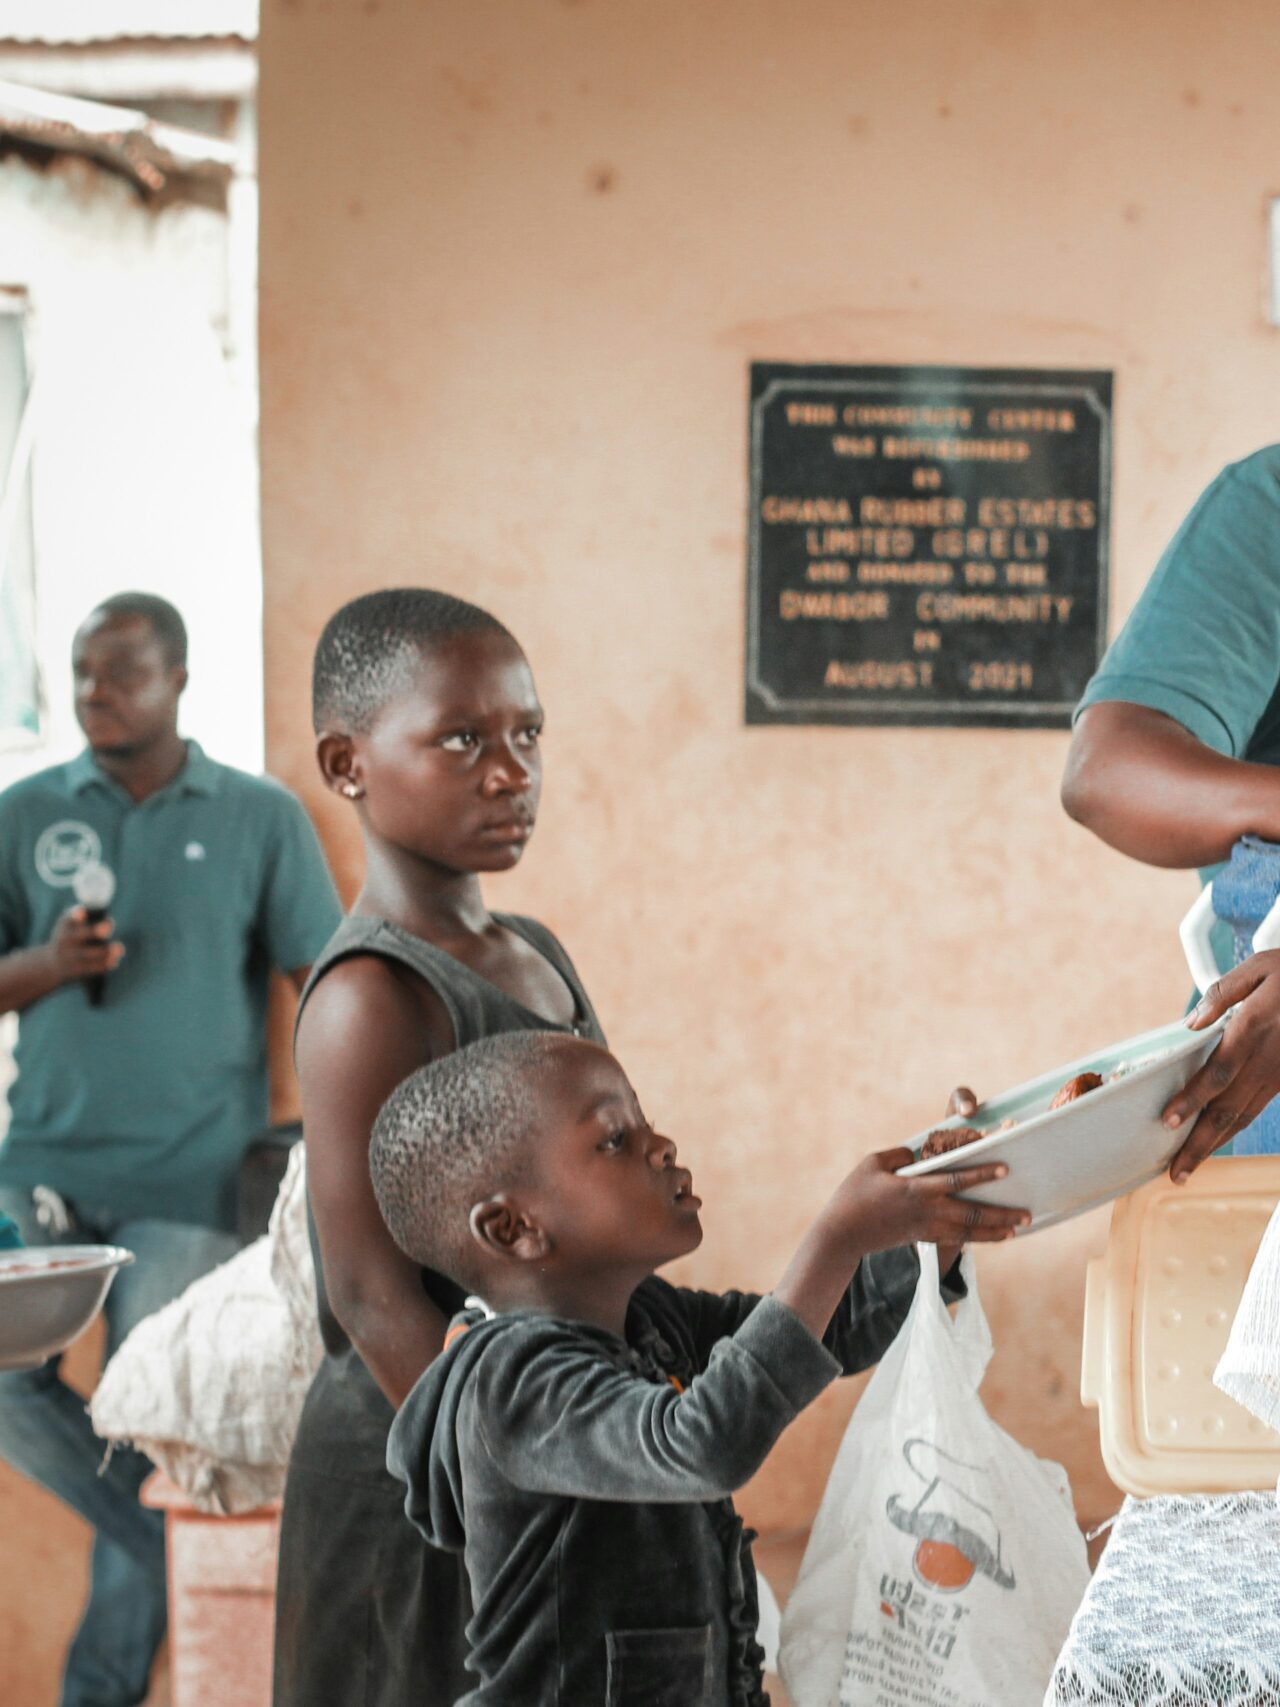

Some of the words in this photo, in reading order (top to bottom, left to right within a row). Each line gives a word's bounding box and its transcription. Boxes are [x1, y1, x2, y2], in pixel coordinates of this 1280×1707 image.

[843, 406, 972, 428] COMMUNITY
[762, 497, 853, 525] GHANA
[860, 498, 967, 526] RUBBER
[978, 499, 1096, 529] ESTATES
[806, 528, 914, 557] LIMITED
[807, 562, 850, 583] AND
[963, 563, 996, 586] TO
[1004, 563, 1047, 586] THE
[916, 594, 1074, 622] COMMUNITY
[825, 661, 934, 688] AUGUST
[968, 663, 1034, 691] 2021
